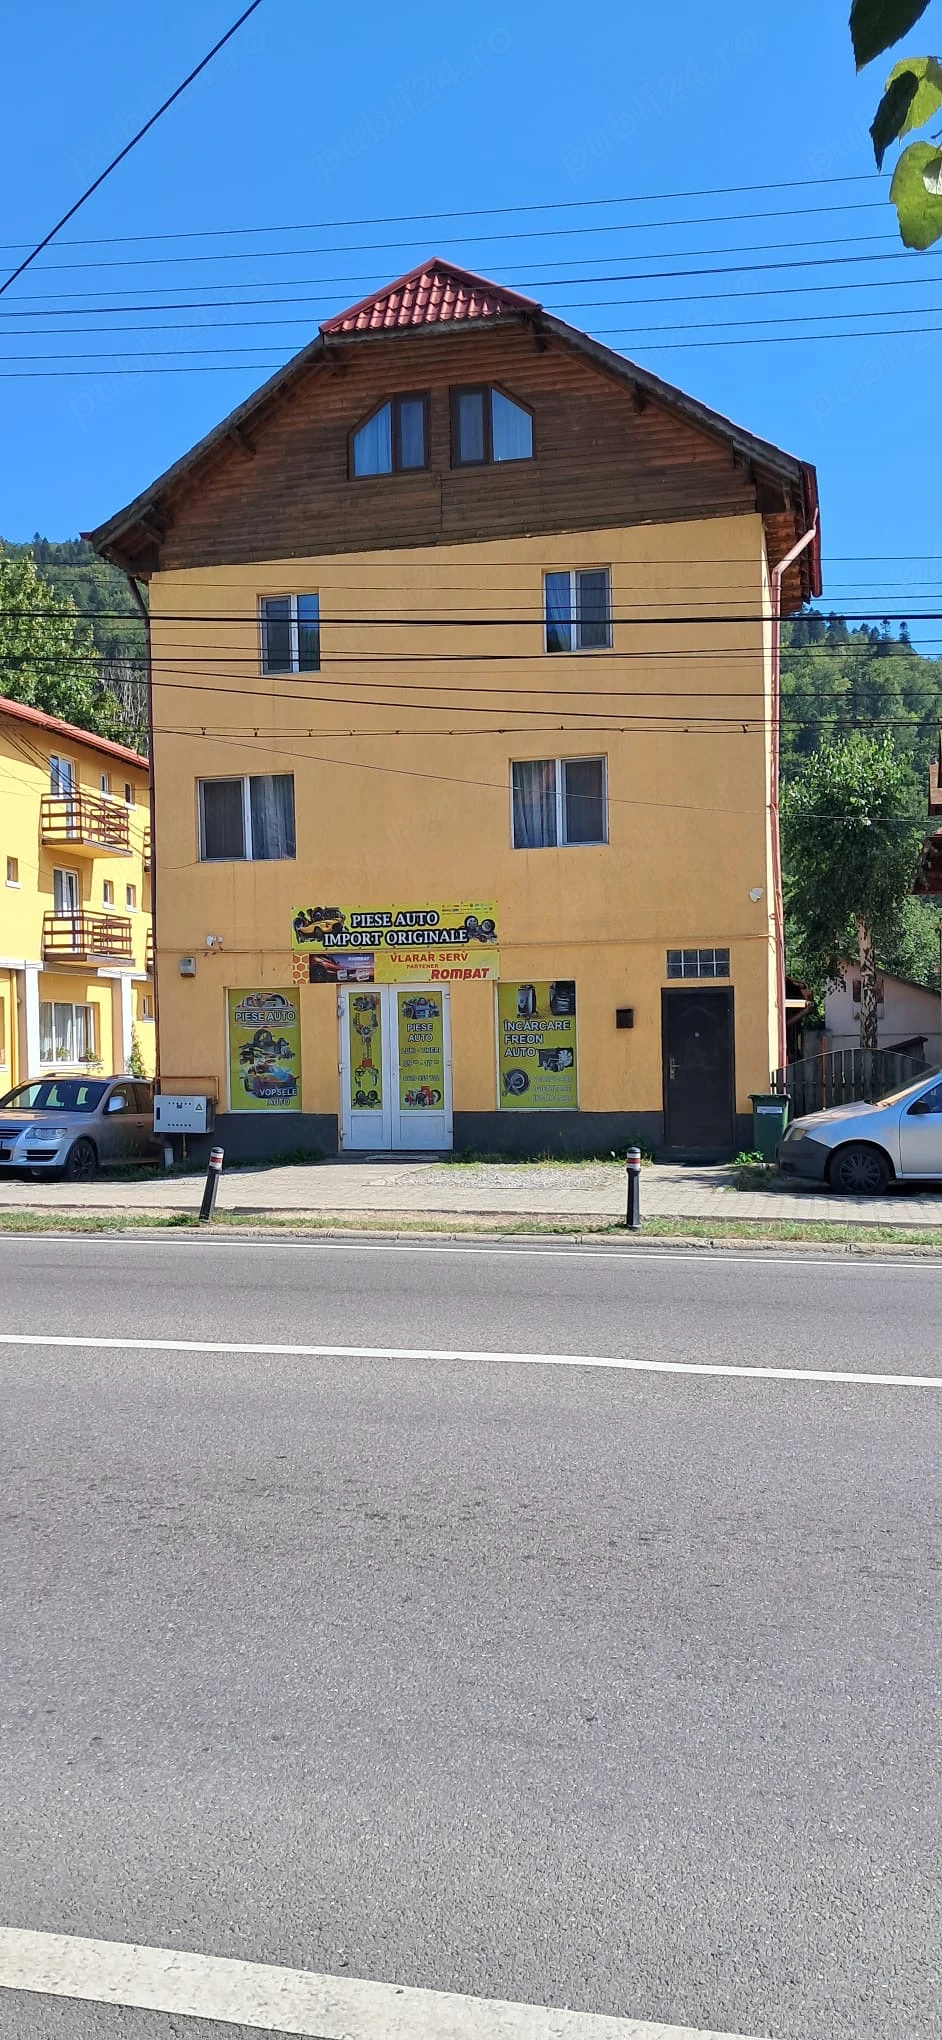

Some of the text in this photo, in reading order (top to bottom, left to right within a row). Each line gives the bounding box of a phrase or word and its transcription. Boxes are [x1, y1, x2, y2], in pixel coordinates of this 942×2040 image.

[351, 911, 439, 928] PIESE AUTO
[323, 929, 468, 947] IMPORT ORIGINALE
[390, 953, 469, 963] VLARAR SERV
[431, 968, 490, 981] ROMBAT
[235, 1011, 295, 1022] PIESE AUTO
[407, 1023, 433, 1032] PIESE
[408, 1034, 433, 1042] AUTO
[504, 1034, 543, 1045] FREON
[504, 1046, 537, 1057] AUTO
[259, 1088, 297, 1097] VOPSELE
[267, 1097, 290, 1106] AUTO
